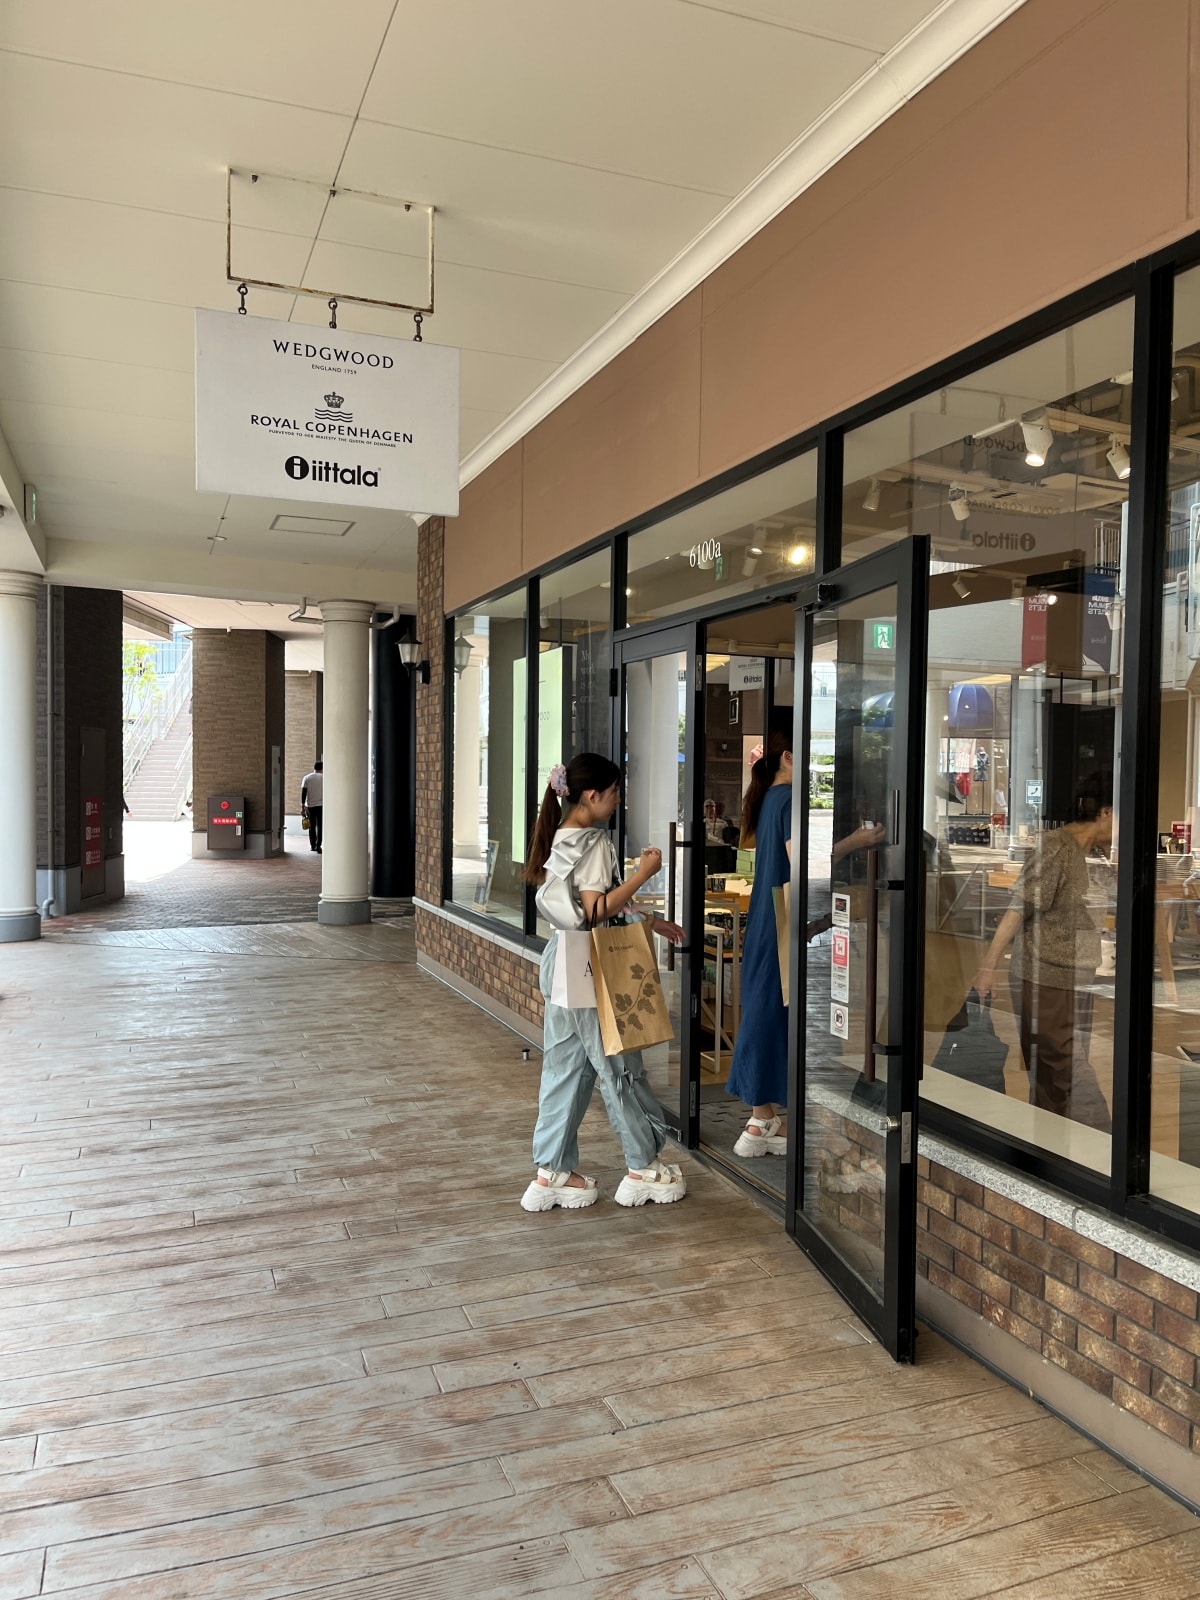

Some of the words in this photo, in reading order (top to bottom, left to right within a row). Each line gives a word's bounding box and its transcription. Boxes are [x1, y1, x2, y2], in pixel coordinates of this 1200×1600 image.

[272, 339, 394, 369] WEDGWOOD
[311, 363, 342, 373] ENGLAND
[250, 414, 300, 430] ROYAL
[305, 421, 413, 444] COPENHAGEN
[312, 460, 378, 487] iittala
[690, 538, 721, 568] 6100a
